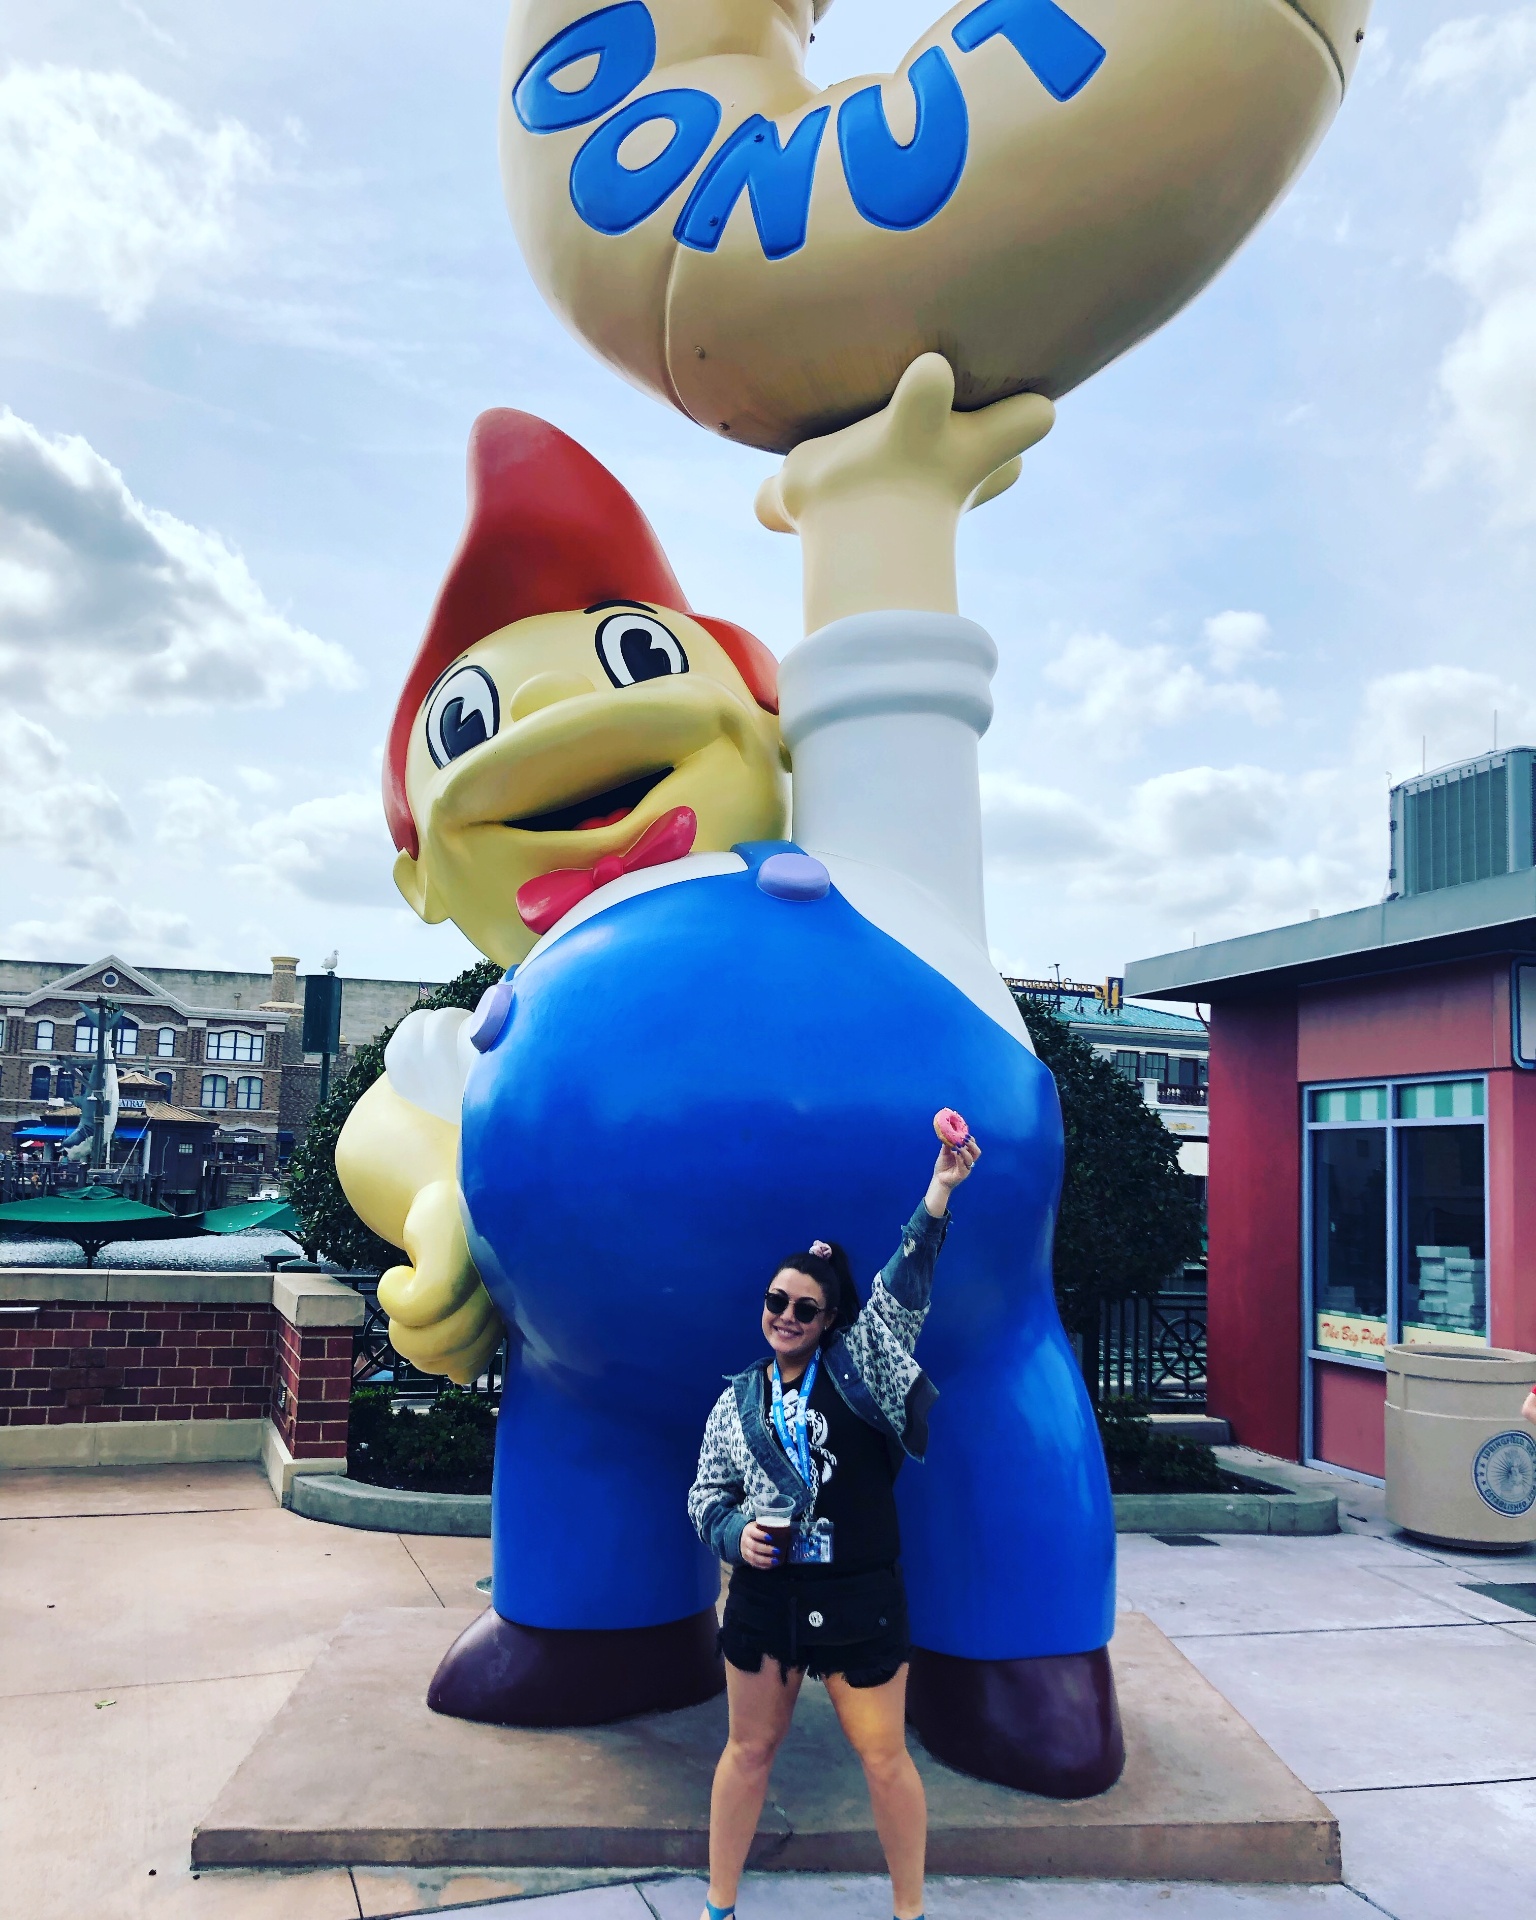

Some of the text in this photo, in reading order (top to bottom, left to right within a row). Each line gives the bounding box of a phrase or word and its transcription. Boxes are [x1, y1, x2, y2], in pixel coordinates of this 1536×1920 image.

[512, 0, 1107, 260] DONUT
[119, 1099, 144, 1108] ATRAZ
[1322, 1322, 1386, 1347] The Big Pink
[1482, 1437, 1525, 1460] SPRINGFIELD
[1484, 1488, 1527, 1511] ESTABLISHED
